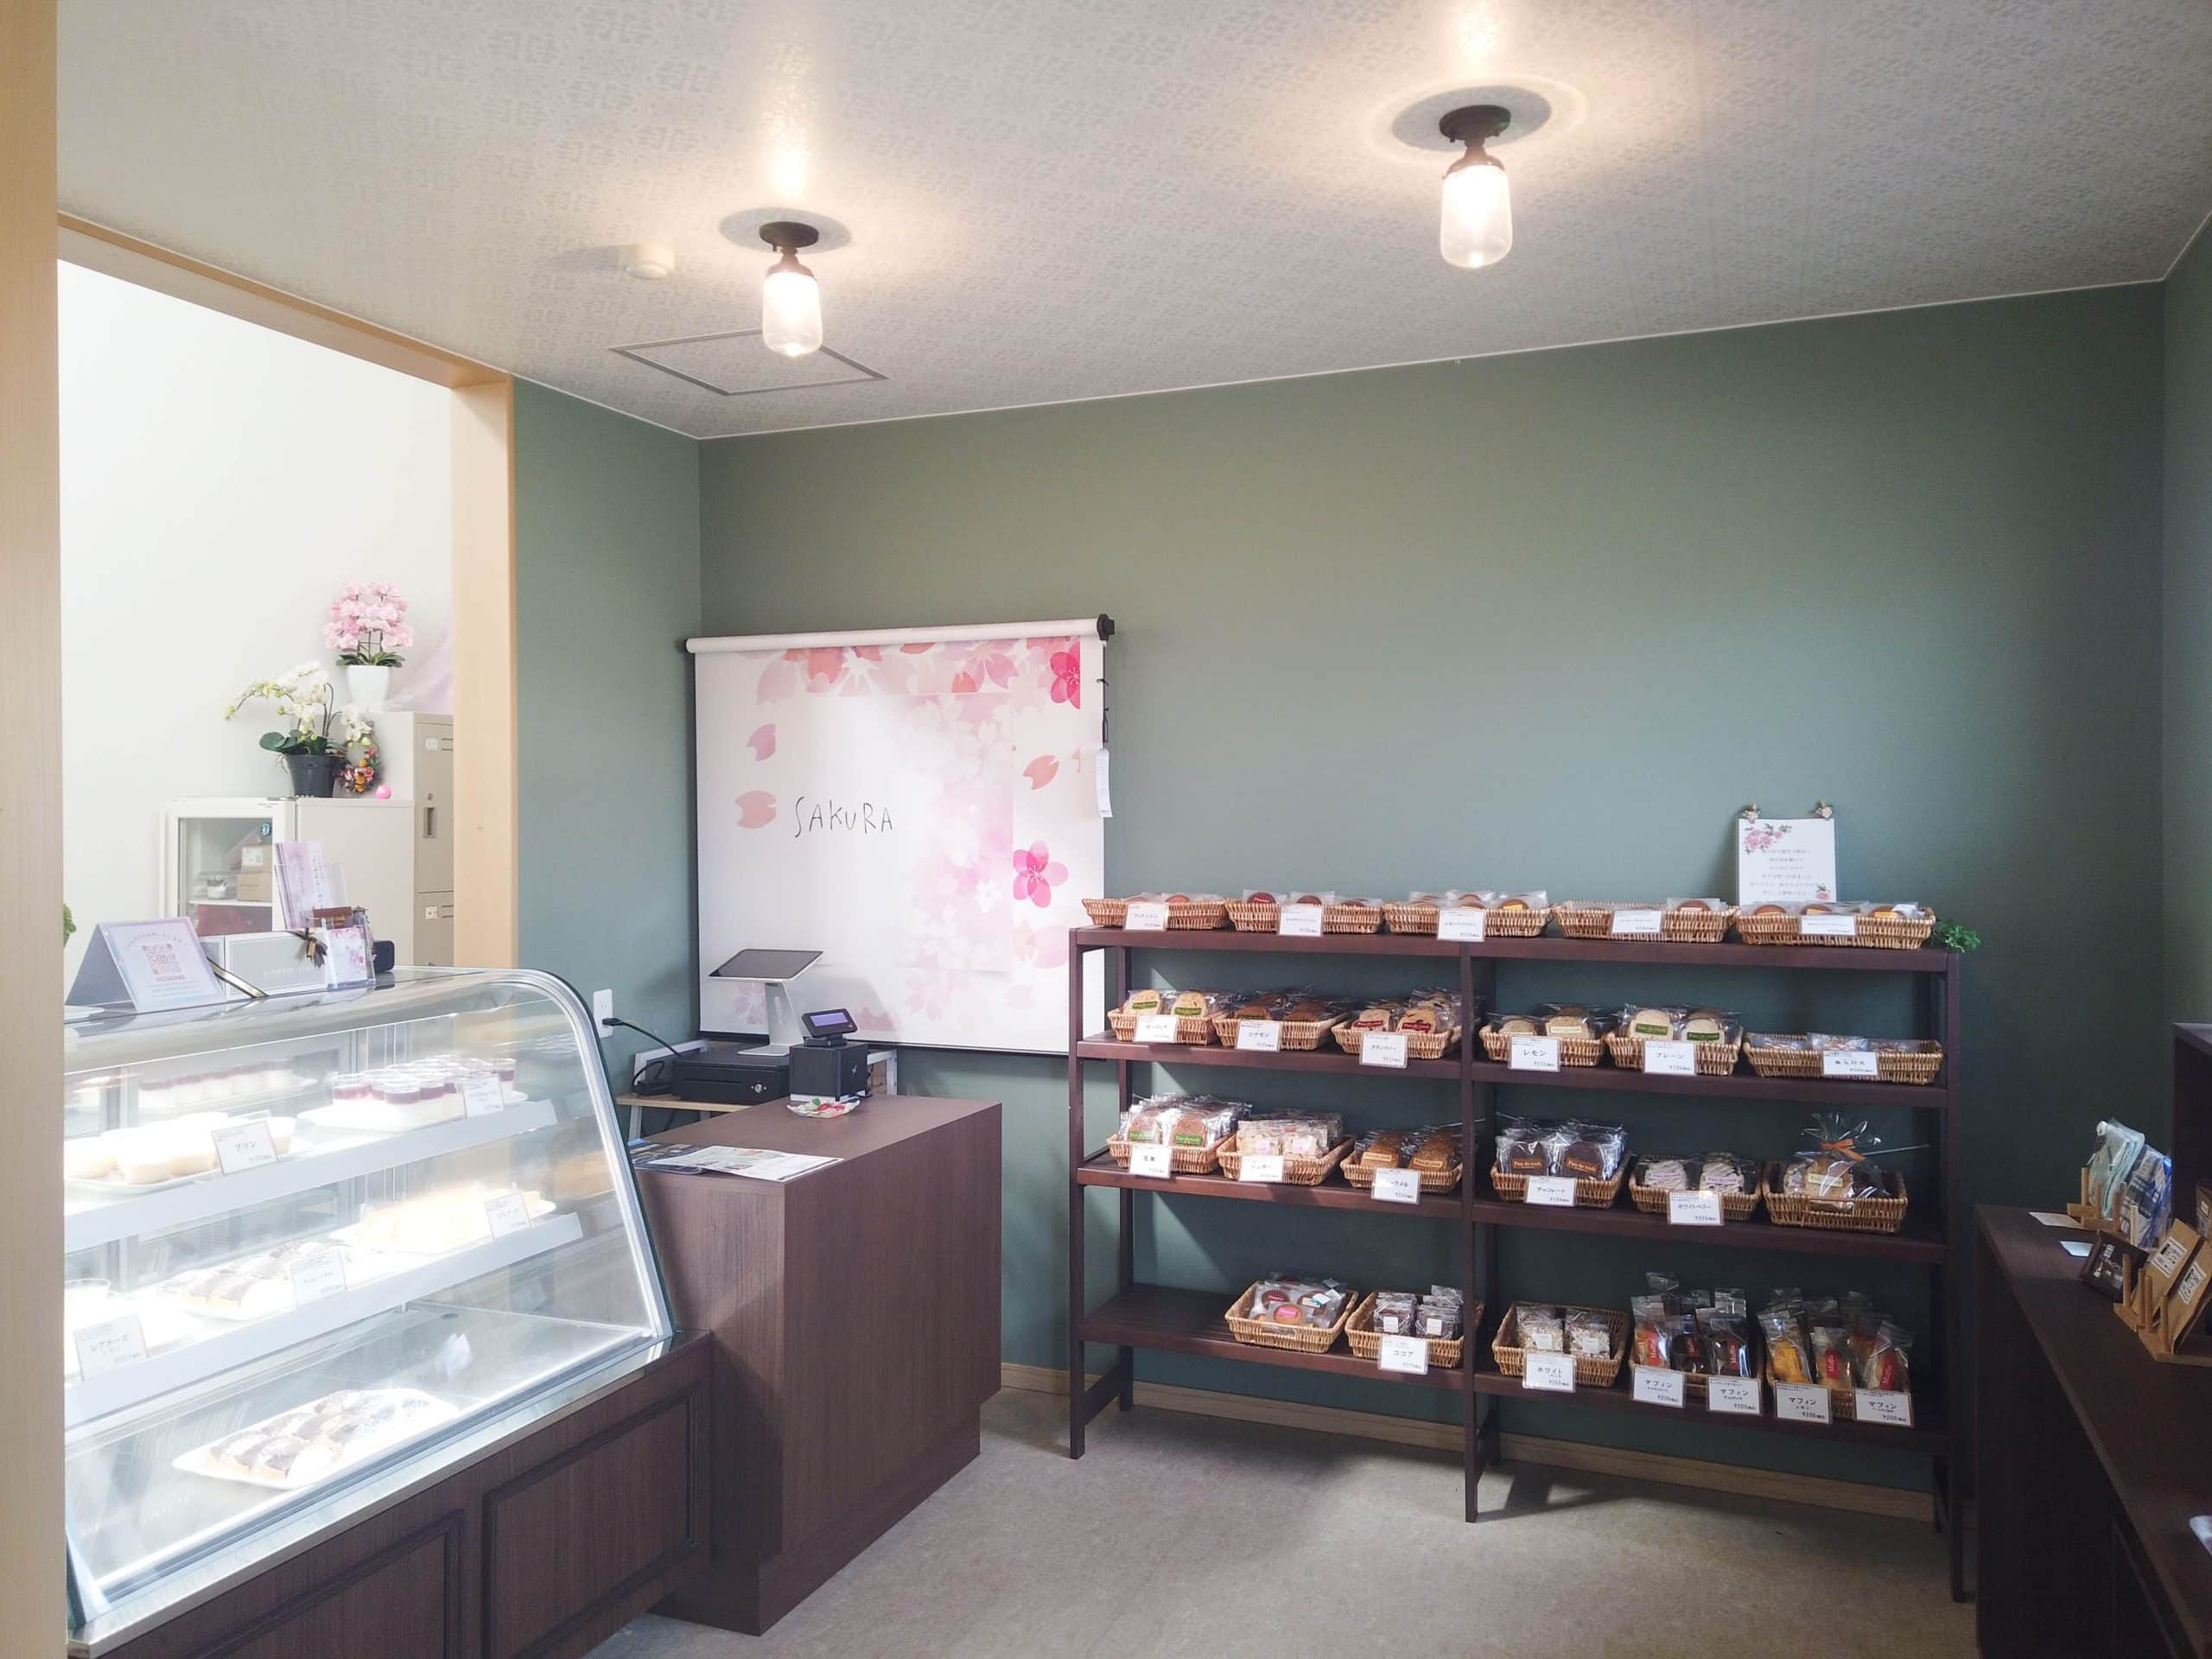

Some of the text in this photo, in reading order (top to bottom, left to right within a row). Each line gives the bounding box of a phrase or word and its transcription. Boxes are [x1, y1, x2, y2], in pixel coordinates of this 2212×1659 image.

[794, 796, 893, 838] SAKURA
[1645, 1379, 1673, 1389] マフィン
